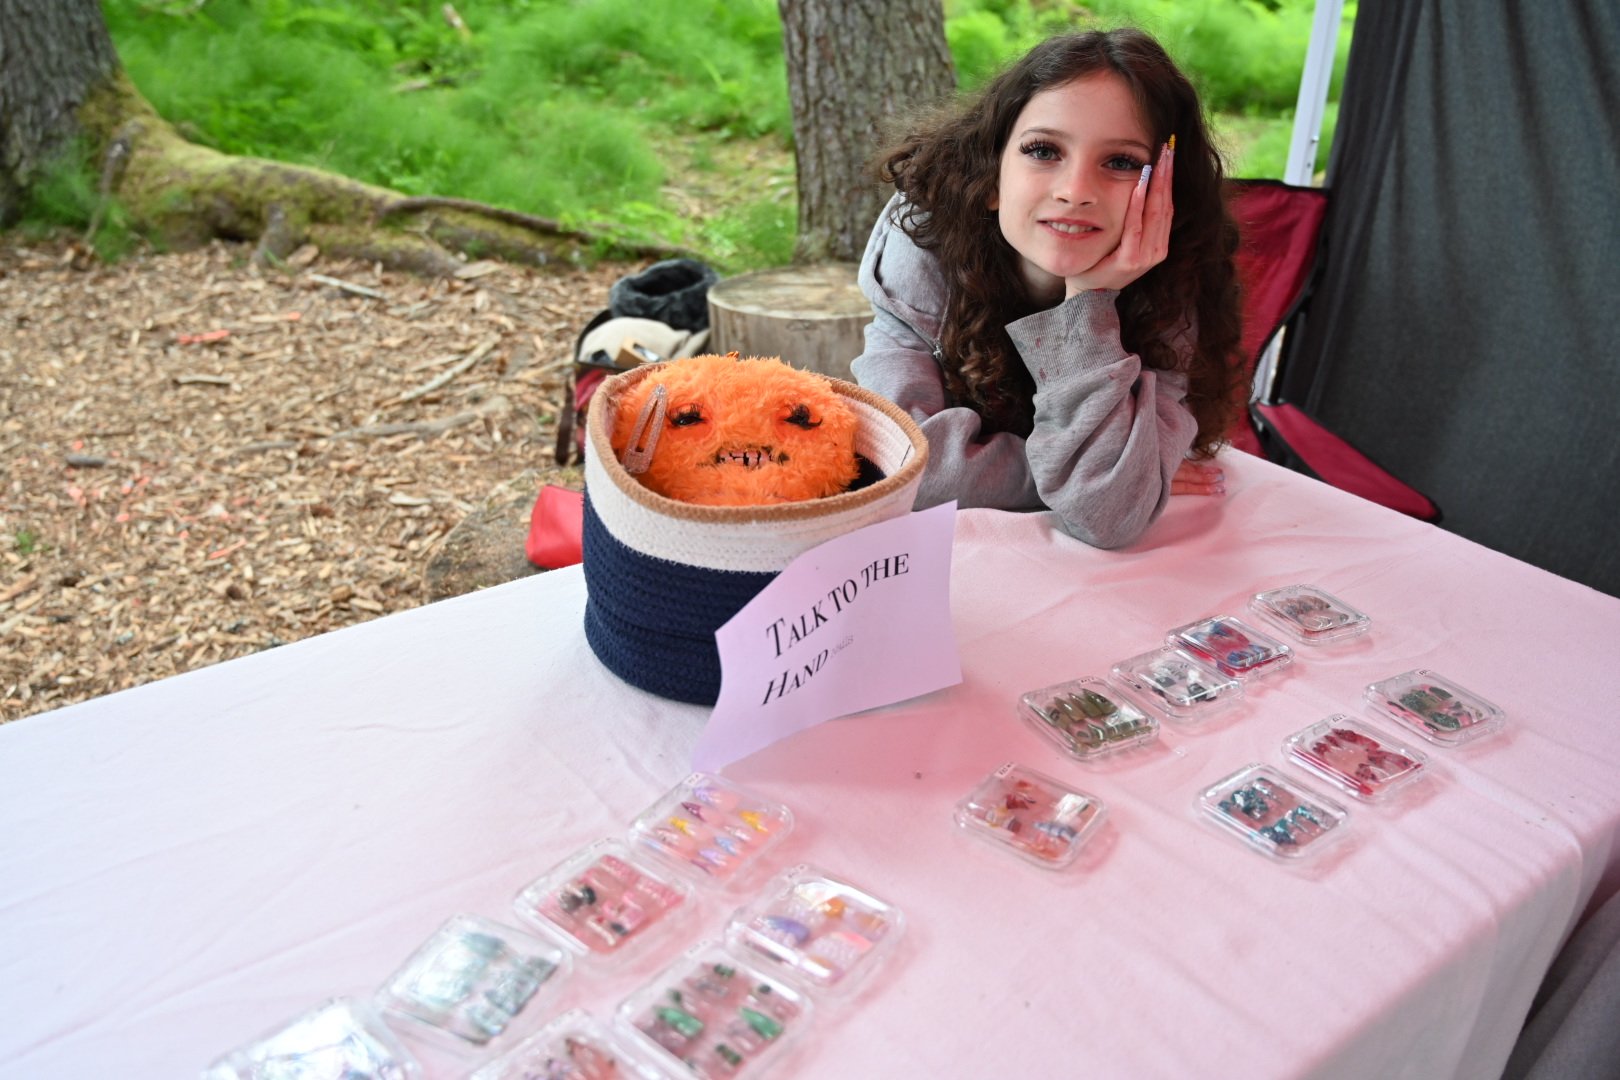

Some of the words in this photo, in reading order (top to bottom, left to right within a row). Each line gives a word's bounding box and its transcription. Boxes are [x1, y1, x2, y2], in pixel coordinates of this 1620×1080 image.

[765, 600, 829, 660] TALK
[827, 578, 858, 614] TO
[860, 552, 910, 589] THE
[762, 648, 829, 706] HAND
